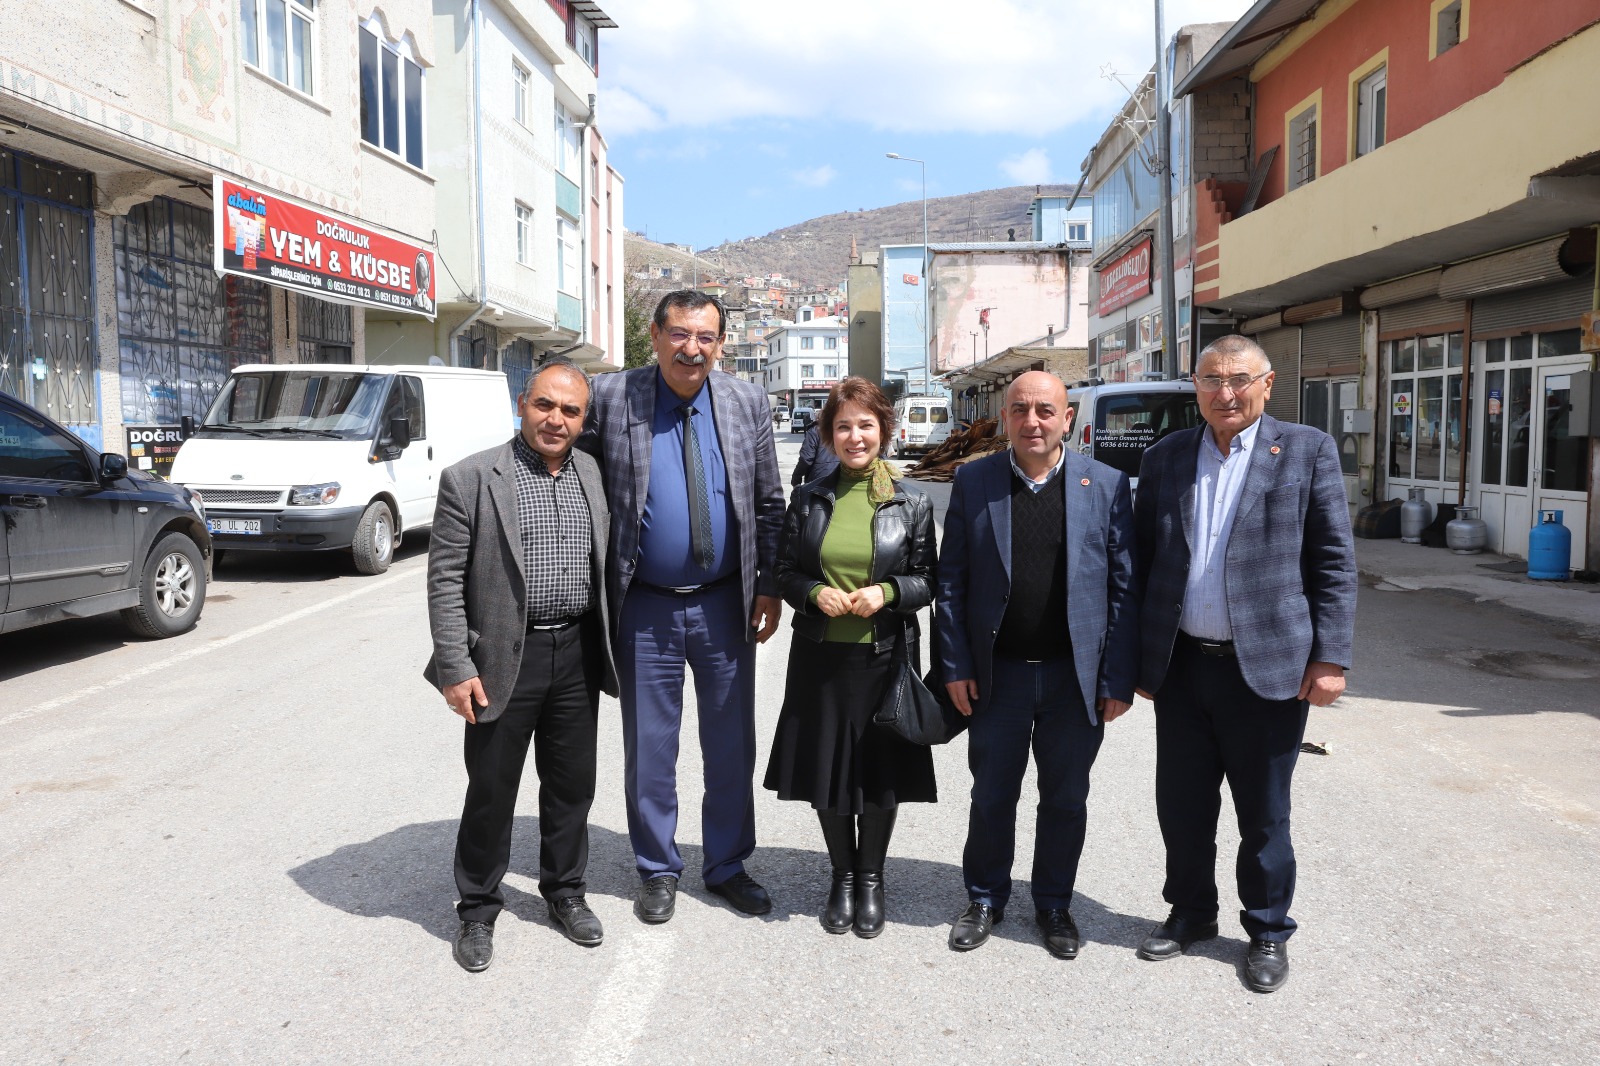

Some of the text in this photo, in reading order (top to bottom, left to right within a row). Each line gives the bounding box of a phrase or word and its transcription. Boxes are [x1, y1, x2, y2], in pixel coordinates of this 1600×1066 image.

[316, 219, 370, 249] DOĞRULUK
[269, 227, 322, 268] YEM
[328, 251, 341, 273] &
[349, 250, 411, 290] KÜSBE
[270, 264, 322, 288] SİPARİŞLERİNİZ İÇİN
[333, 280, 346, 293] 0533
[347, 284, 356, 295] 227
[211, 520, 259, 531] 38 UL 202
